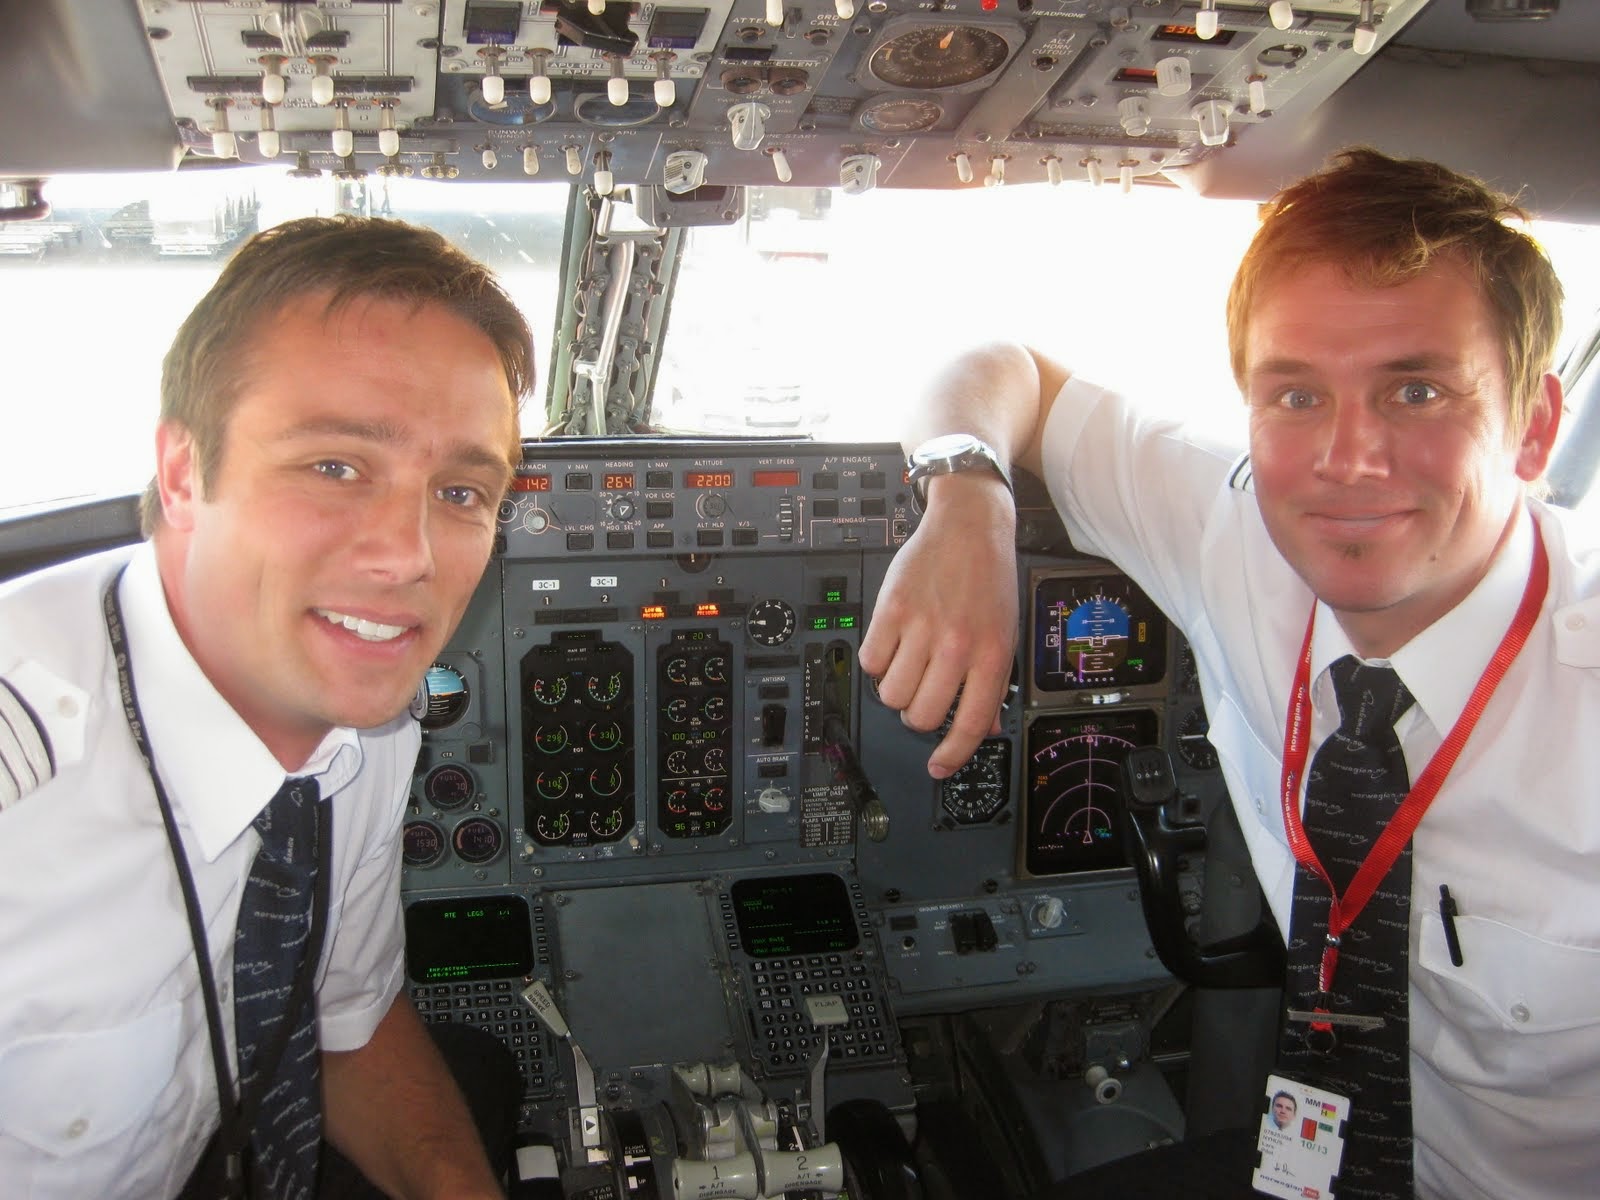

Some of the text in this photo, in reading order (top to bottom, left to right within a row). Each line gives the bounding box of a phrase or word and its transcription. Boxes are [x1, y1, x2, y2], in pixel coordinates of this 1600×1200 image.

[526, 478, 548, 490] 142
[606, 477, 633, 489] 264
[697, 474, 731, 487] 2200
[1291, 686, 1304, 752] norwegian.no
[1286, 775, 1298, 844] norwegian.no
[528, 994, 546, 1013] BRAKE
[534, 990, 550, 1008] SPEED
[1305, 1098, 1320, 1108] MM
[1301, 1140, 1328, 1155] 10/13
[797, 1156, 808, 1170] 2
[712, 1165, 720, 1180] 1
[784, 1180, 822, 1188] DISENGAGE
[1260, 1174, 1302, 1192] norwegian
[588, 1186, 611, 1196] STAB
[699, 1189, 736, 1198] DISENGAGE
